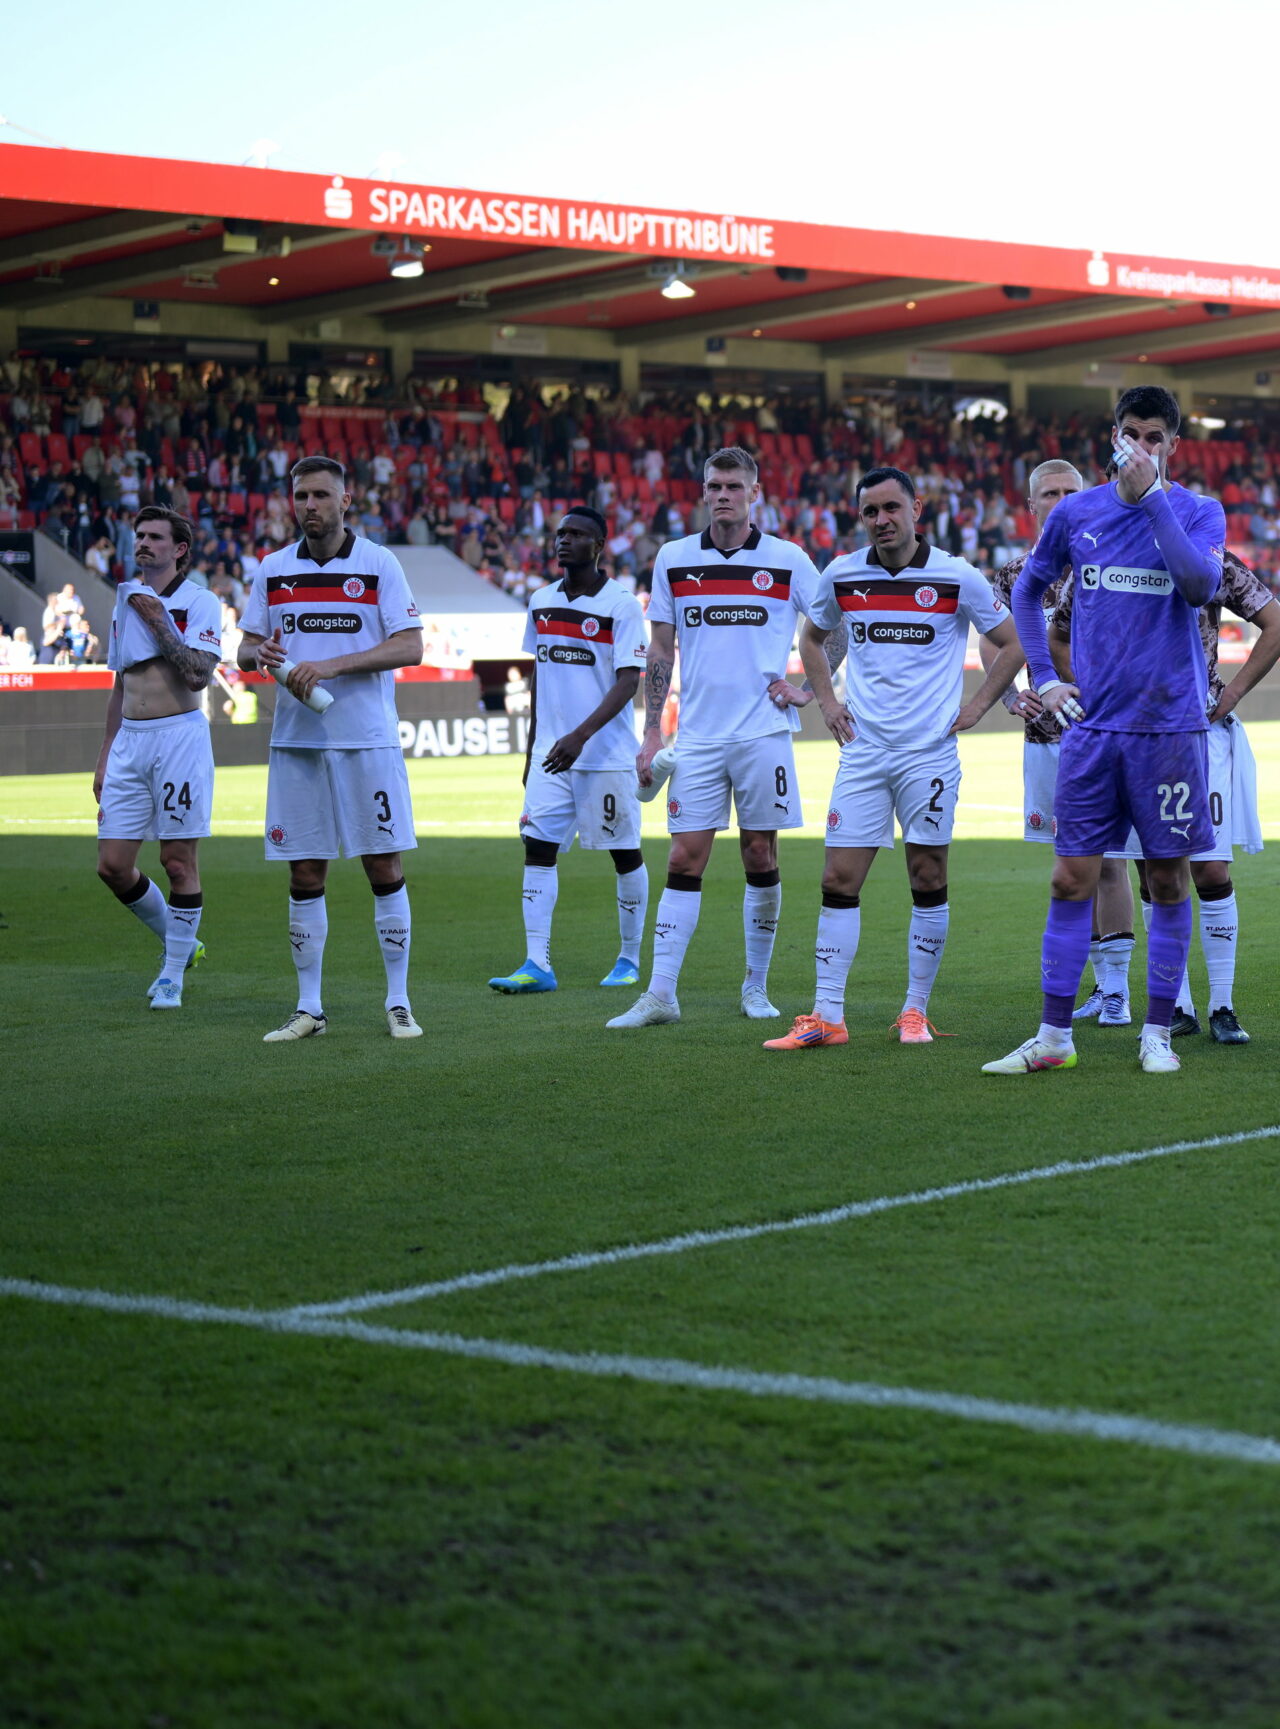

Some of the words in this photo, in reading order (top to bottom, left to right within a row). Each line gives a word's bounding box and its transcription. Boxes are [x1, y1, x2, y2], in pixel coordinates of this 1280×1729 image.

[369, 188, 560, 239] SPARKASSEN
[568, 207, 776, 257] HAUPTTRIBÜNE
[1109, 573, 1170, 588] congstar
[303, 615, 357, 628] congstar
[709, 610, 764, 622] congstar
[874, 628, 930, 641] congstar
[553, 650, 592, 662] congstar
[397, 718, 511, 757] PAUSE
[775, 766, 788, 797] 8
[929, 777, 945, 813] 2
[163, 782, 192, 811] 24
[374, 790, 392, 823] 3
[603, 793, 616, 822] 9
[1158, 782, 1194, 821] 22
